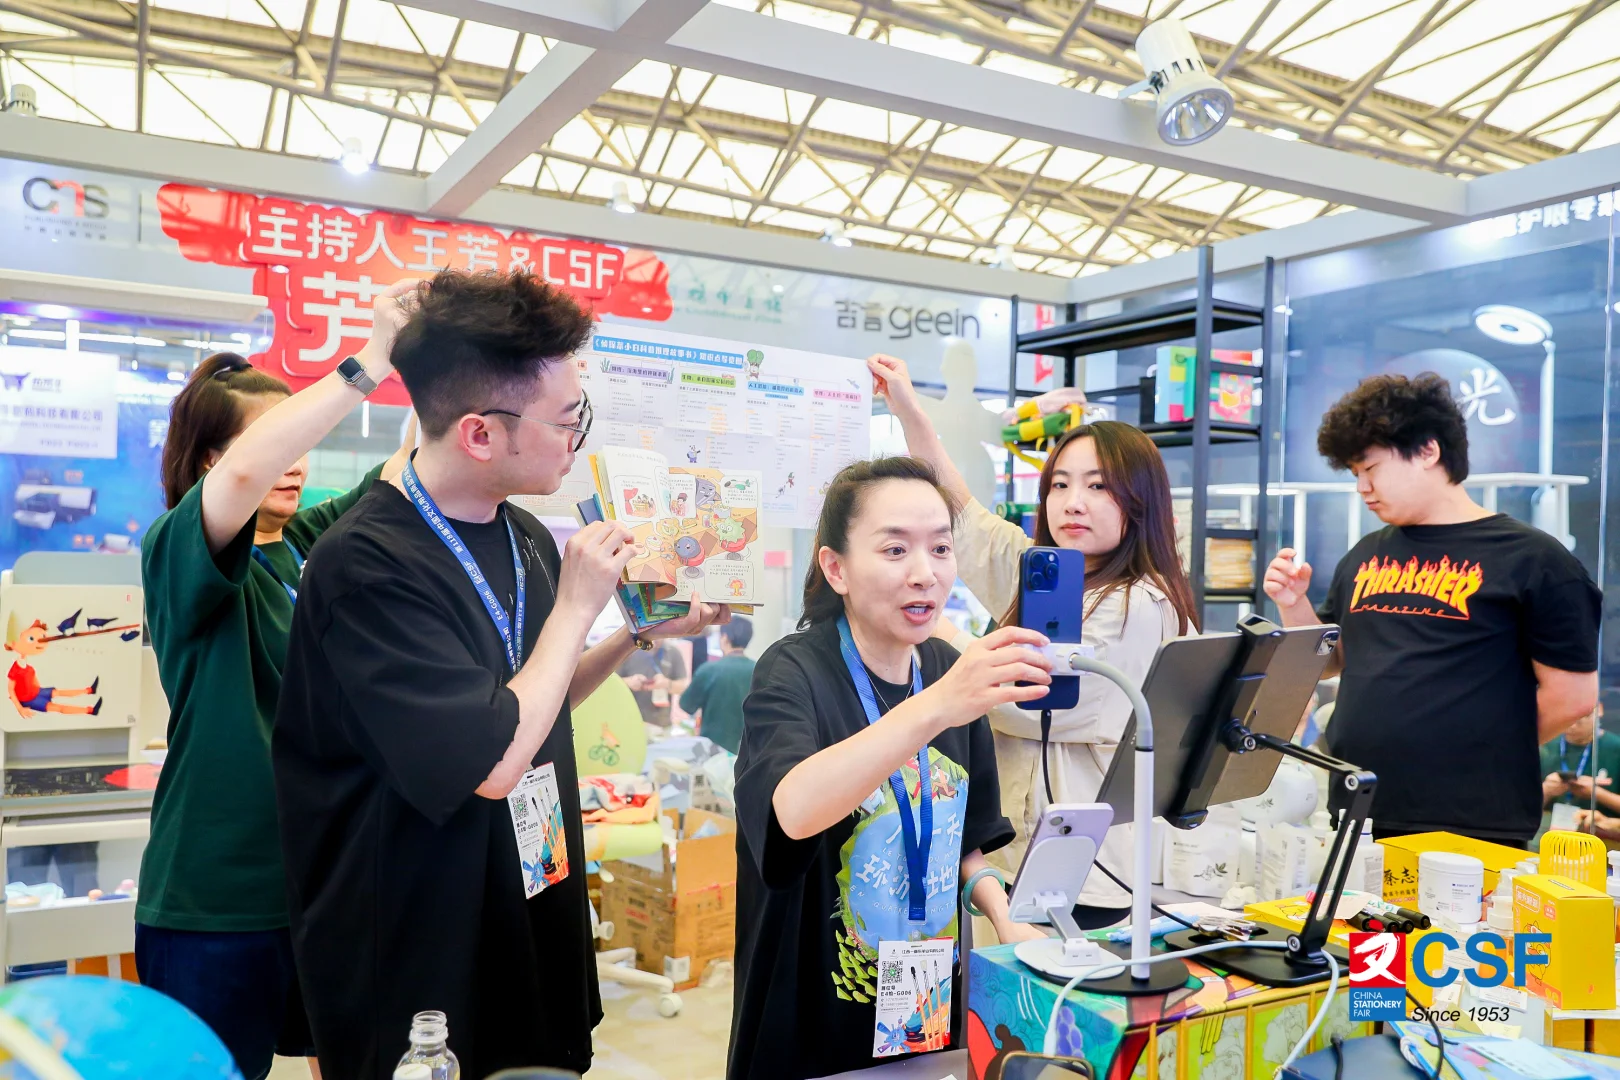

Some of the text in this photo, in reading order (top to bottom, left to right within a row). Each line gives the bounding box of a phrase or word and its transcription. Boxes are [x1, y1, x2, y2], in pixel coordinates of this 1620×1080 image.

[888, 303, 981, 340] geein
[1456, 367, 1516, 426] 光
[1350, 554, 1484, 618] THRASHER
[1361, 603, 1445, 617] MAGAZINE
